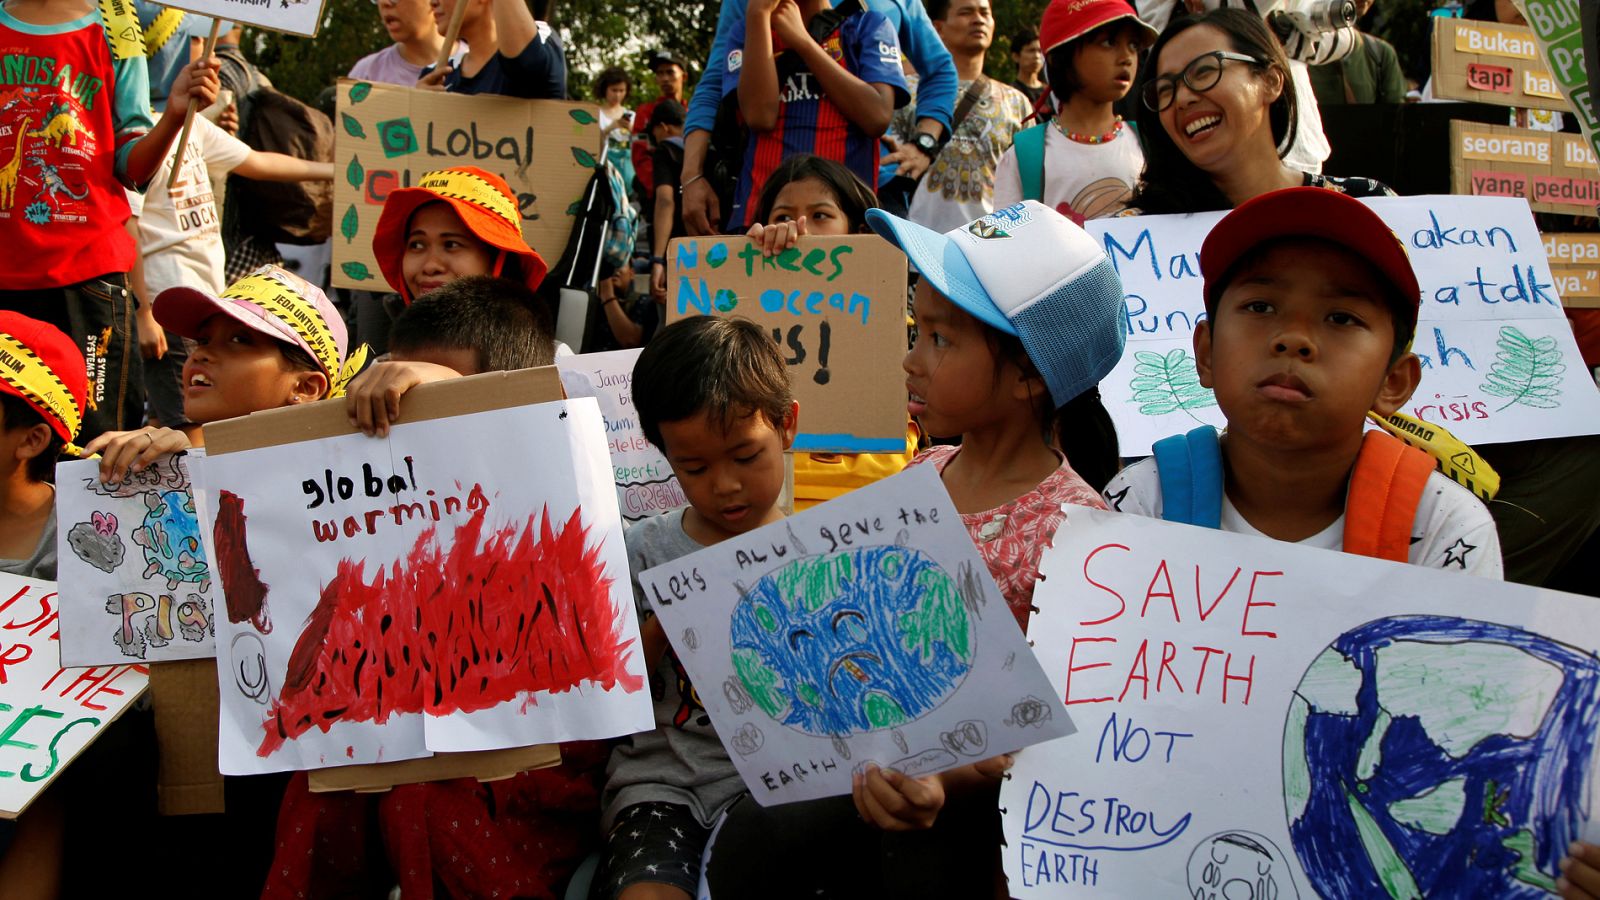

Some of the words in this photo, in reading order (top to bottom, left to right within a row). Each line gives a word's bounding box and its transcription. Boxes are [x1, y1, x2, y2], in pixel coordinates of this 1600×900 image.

[0, 54, 103, 110] NOSAUR
[1470, 66, 1512, 90] tapi
[1463, 136, 1549, 161] seorang
[1474, 175, 1526, 198] yang
[1535, 178, 1599, 201] peduli
[180, 205, 217, 231] DOCK
[1411, 209, 1517, 252] akan
[272, 294, 295, 313] JEDA
[294, 308, 319, 338] UNTUK
[677, 276, 738, 316] No
[760, 289, 870, 325] ocean
[86, 334, 98, 377] SYSTEMS
[96, 357, 107, 402] SYMBOLS
[1413, 393, 1489, 421] risis
[302, 455, 418, 510] global
[613, 459, 662, 481] eperti
[312, 482, 490, 543] warming
[898, 507, 940, 527] the
[1080, 543, 1284, 638] SAVE
[1065, 637, 1255, 706] EARTH
[1096, 711, 1194, 763] NOT
[760, 757, 837, 792] EARTH
[1021, 841, 1099, 888] EARTH
